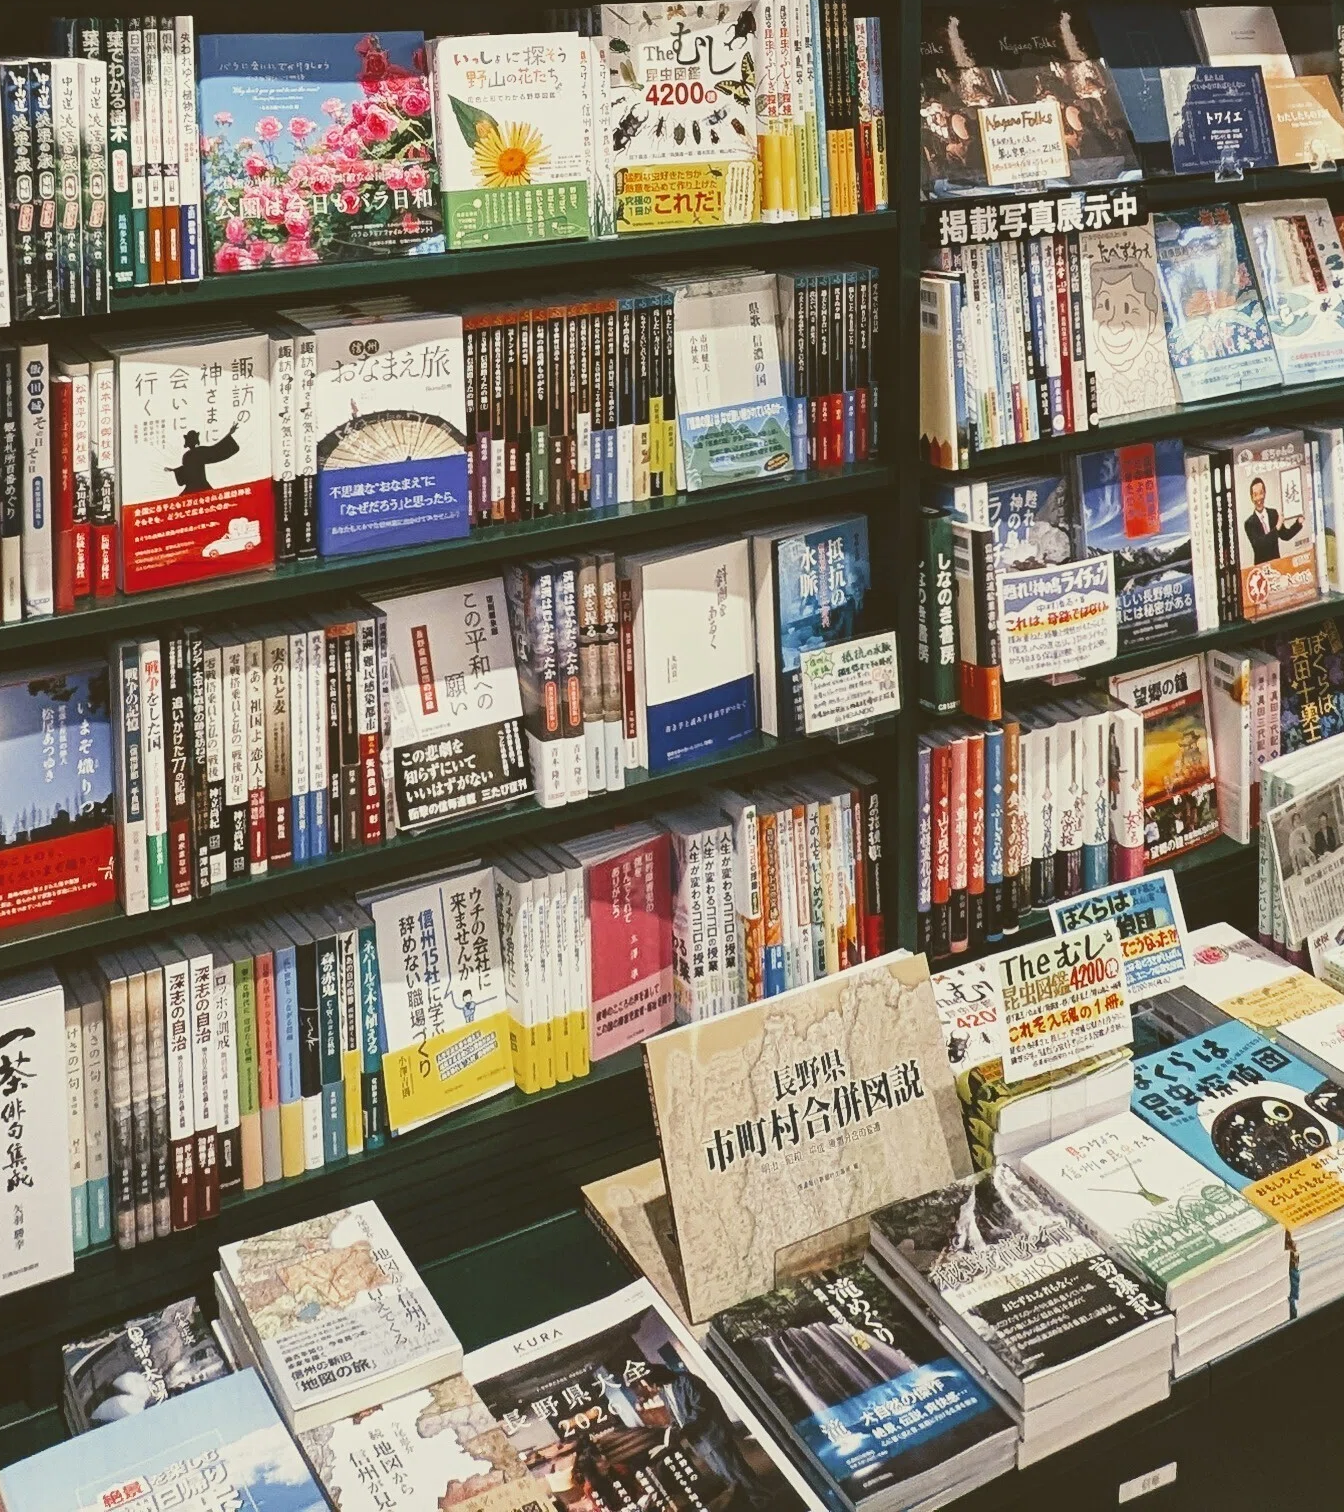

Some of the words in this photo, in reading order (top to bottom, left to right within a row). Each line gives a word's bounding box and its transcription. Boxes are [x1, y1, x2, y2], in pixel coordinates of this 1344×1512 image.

[452, 44, 567, 67] いっしょに探そう
[644, 44, 674, 62] The
[672, 22, 736, 76] むし
[645, 66, 701, 82] 昆虫図鑑
[106, 31, 129, 142] 葉でわかる樹木
[465, 67, 560, 90] 野山の花たち
[986, 114, 1021, 132] Nagano
[1021, 110, 1053, 128] Folks
[1206, 110, 1243, 125] トワイエ
[624, 170, 703, 183] 猛烈な虫好きたちが
[654, 192, 723, 215] これだ!
[215, 187, 434, 223] 公園は今日もバラ日和
[939, 191, 1138, 246] 掲載写真展示中
[748, 301, 761, 327] 県歌
[329, 345, 451, 385] おなまえ旅
[699, 334, 711, 373] 市川健夫
[752, 334, 767, 387] 信濃の国
[135, 371, 159, 417] 行く
[169, 367, 190, 431] 会いに
[200, 363, 223, 443] 神さまに
[231, 356, 255, 423] 諏訪の
[340, 491, 458, 516] 「なぜだろう」と思ったら、
[1284, 480, 1300, 504] 続
[799, 544, 819, 601] 水脈
[826, 536, 846, 608] 抵抗の
[936, 552, 956, 665] しなのき書房
[463, 591, 494, 711] この平和への
[1302, 628, 1336, 712] ぼくらは
[144, 659, 162, 751] 戦争をした国
[446, 672, 469, 716] 願い
[1132, 669, 1190, 710] 望郷の鐘
[1288, 637, 1322, 744] 真田十勇士
[42, 706, 54, 784] 松尾あつゆき
[171, 696, 186, 806] 追いかけた77の記憶
[400, 739, 464, 767] この悲劇を
[403, 753, 477, 785] 知らずにいて
[406, 771, 494, 802] いいはずがない
[972, 806, 984, 879] ゆかいな話
[990, 803, 1004, 877] ふしぎな話
[689, 838, 703, 980] 人生が変わるココロの授業
[704, 835, 719, 974] 人生が変わるココロの授業
[1061, 890, 1131, 930] ぼくらは
[449, 892, 473, 982] 来ませんか
[467, 886, 492, 992] ウチの会社に
[999, 952, 1051, 987] The
[1053, 934, 1106, 970] むし
[321, 952, 337, 998] 森の赤鬼
[362, 938, 378, 1055] ネパールで木を植える
[397, 914, 433, 1079] 辞めない職場づくり
[1002, 970, 1072, 1012] 昆虫図鑑
[169, 972, 186, 1053] 深志の自治
[66, 1026, 80, 1091] けさの一句
[771, 1047, 847, 1104] 長野県
[1133, 1037, 1230, 1091] ぼくらは
[1137, 1045, 1293, 1122] 昆虫探偵団
[701, 1058, 926, 1175] 市町村合併図説
[0, 1097, 35, 1193] 俳句集成
[1060, 1134, 1157, 1181] 信州の昆虫たち
[1065, 1132, 1120, 1159] 見つけよう
[1255, 1168, 1307, 1198] おもしろくて
[928, 1220, 1077, 1292] 秘境滝紀行
[828, 1276, 897, 1347] 滝めぐり
[1087, 1255, 1162, 1318] 訪瀑記
[290, 1351, 354, 1381] 信州の新旧
[512, 1327, 565, 1354] KURA
[292, 1359, 380, 1394] 「地図の旅」
[500, 1356, 653, 1439] 長野県大全
[860, 1378, 946, 1427] 大自然の傑作
